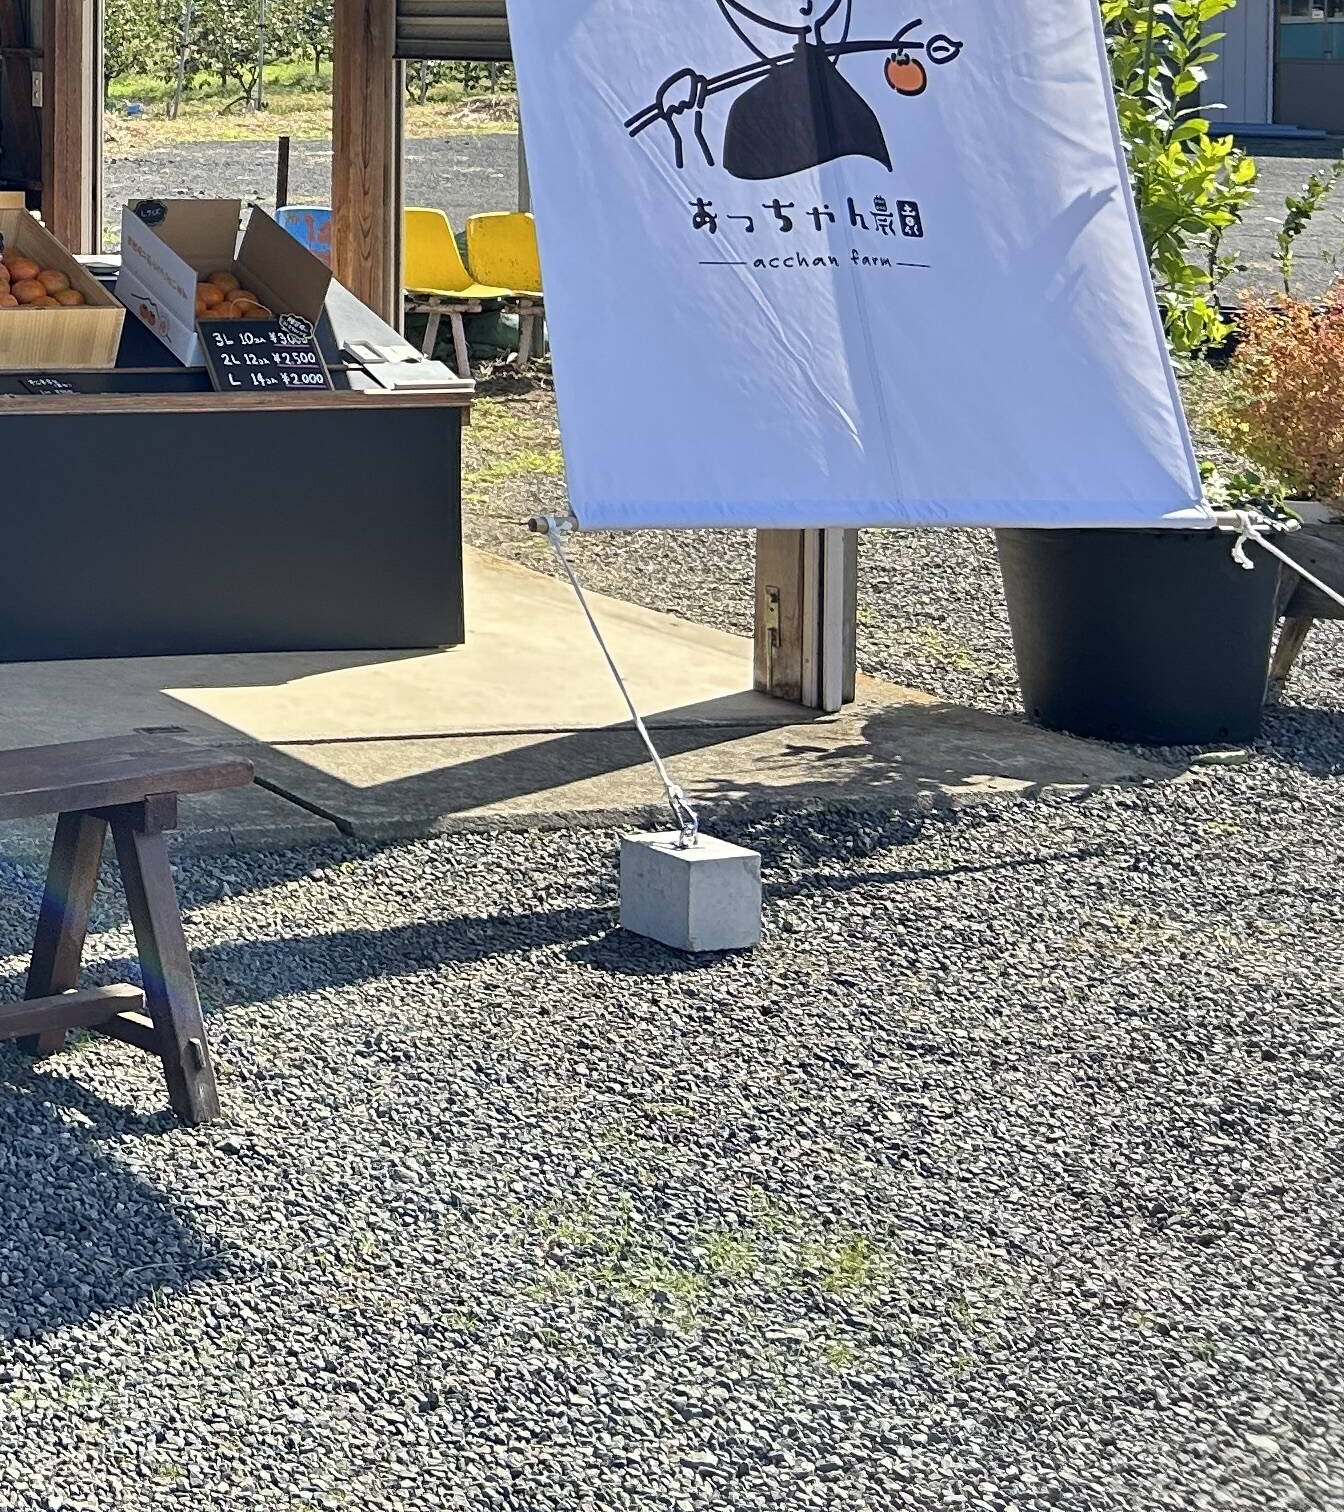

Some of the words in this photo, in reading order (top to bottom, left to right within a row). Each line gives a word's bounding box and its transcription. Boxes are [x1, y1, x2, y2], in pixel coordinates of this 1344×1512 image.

[753, 252, 840, 268] acchan
[850, 248, 892, 268] farm
[212, 332, 234, 347] 3L
[220, 353, 241, 365] 2L
[228, 373, 242, 386] L
